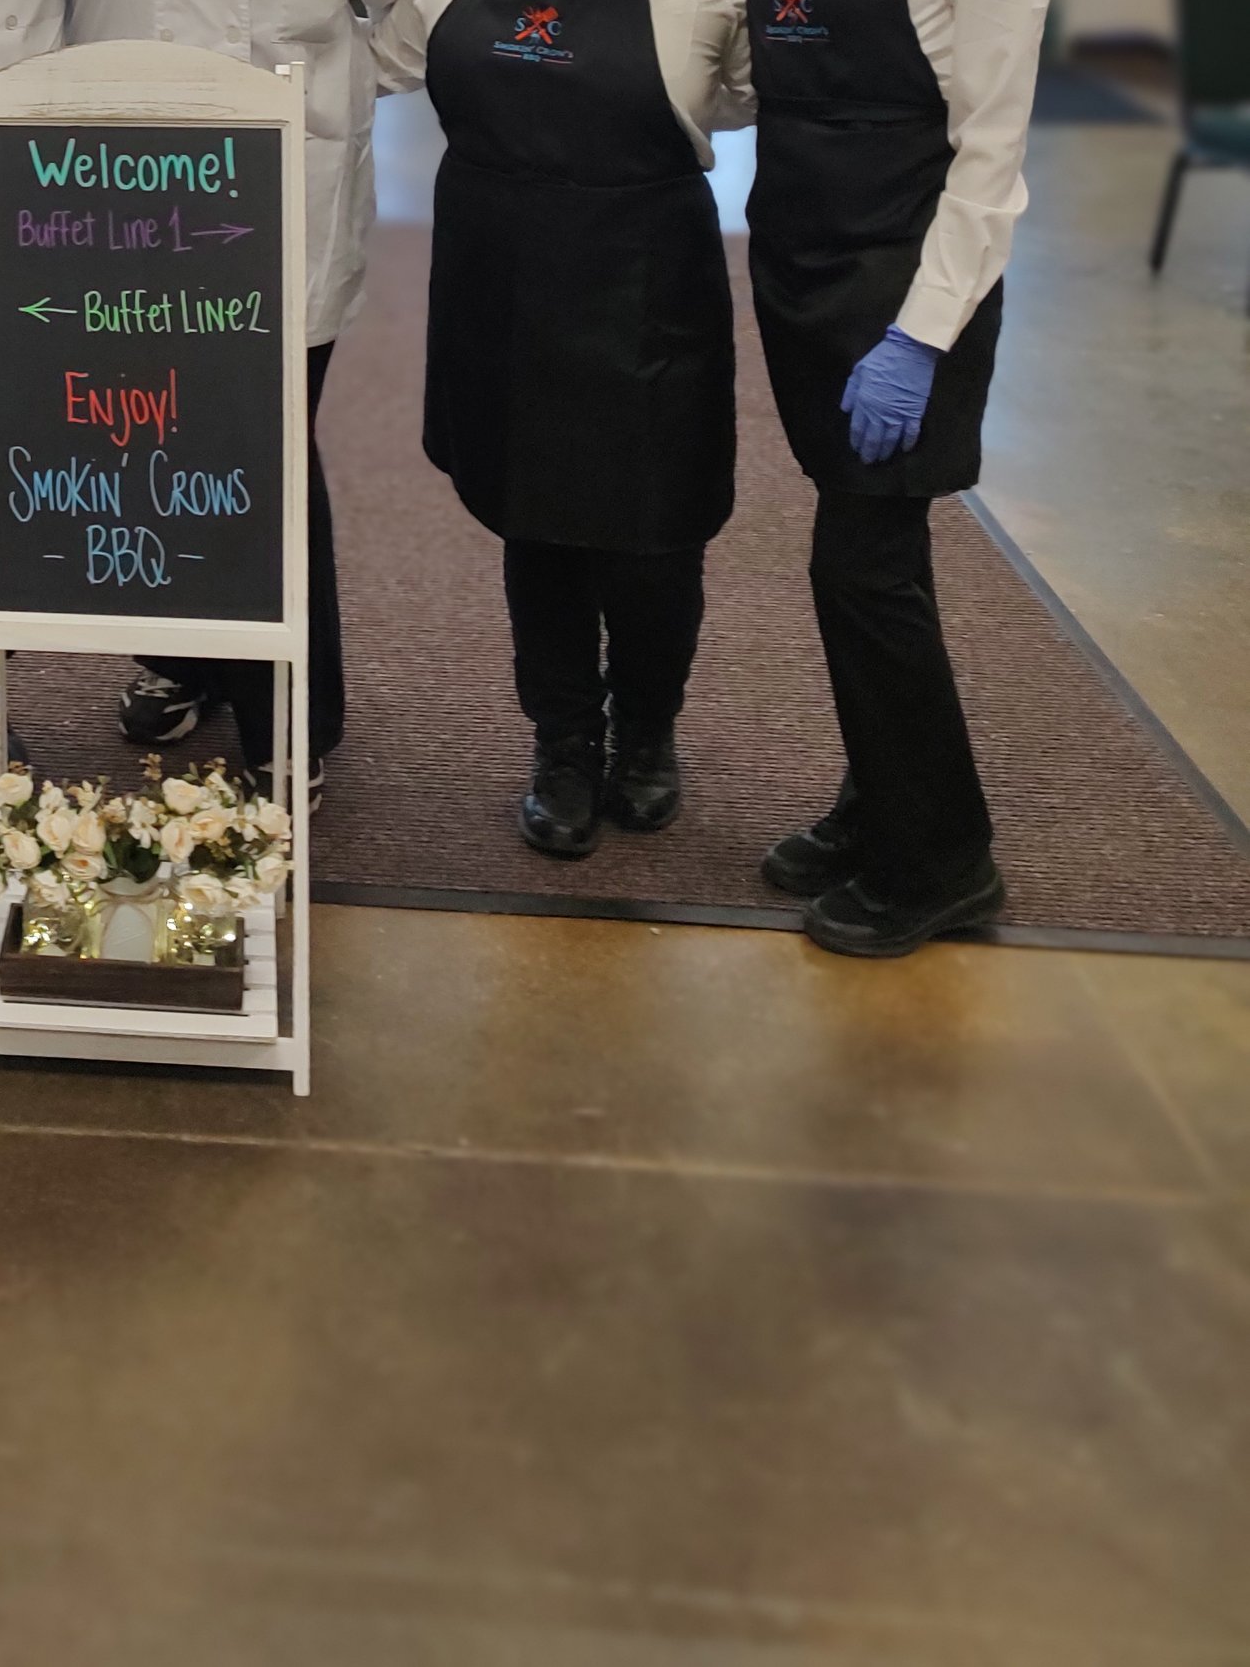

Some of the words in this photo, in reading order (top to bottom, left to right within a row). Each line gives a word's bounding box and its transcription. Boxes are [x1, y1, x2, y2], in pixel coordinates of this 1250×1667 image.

[28, 137, 239, 198] Welcome!
[17, 209, 95, 247] Buffet
[168, 205, 193, 252] 1
[83, 289, 172, 334] Buffet
[246, 290, 271, 333] 2
[85, 524, 172, 588] BBQ
